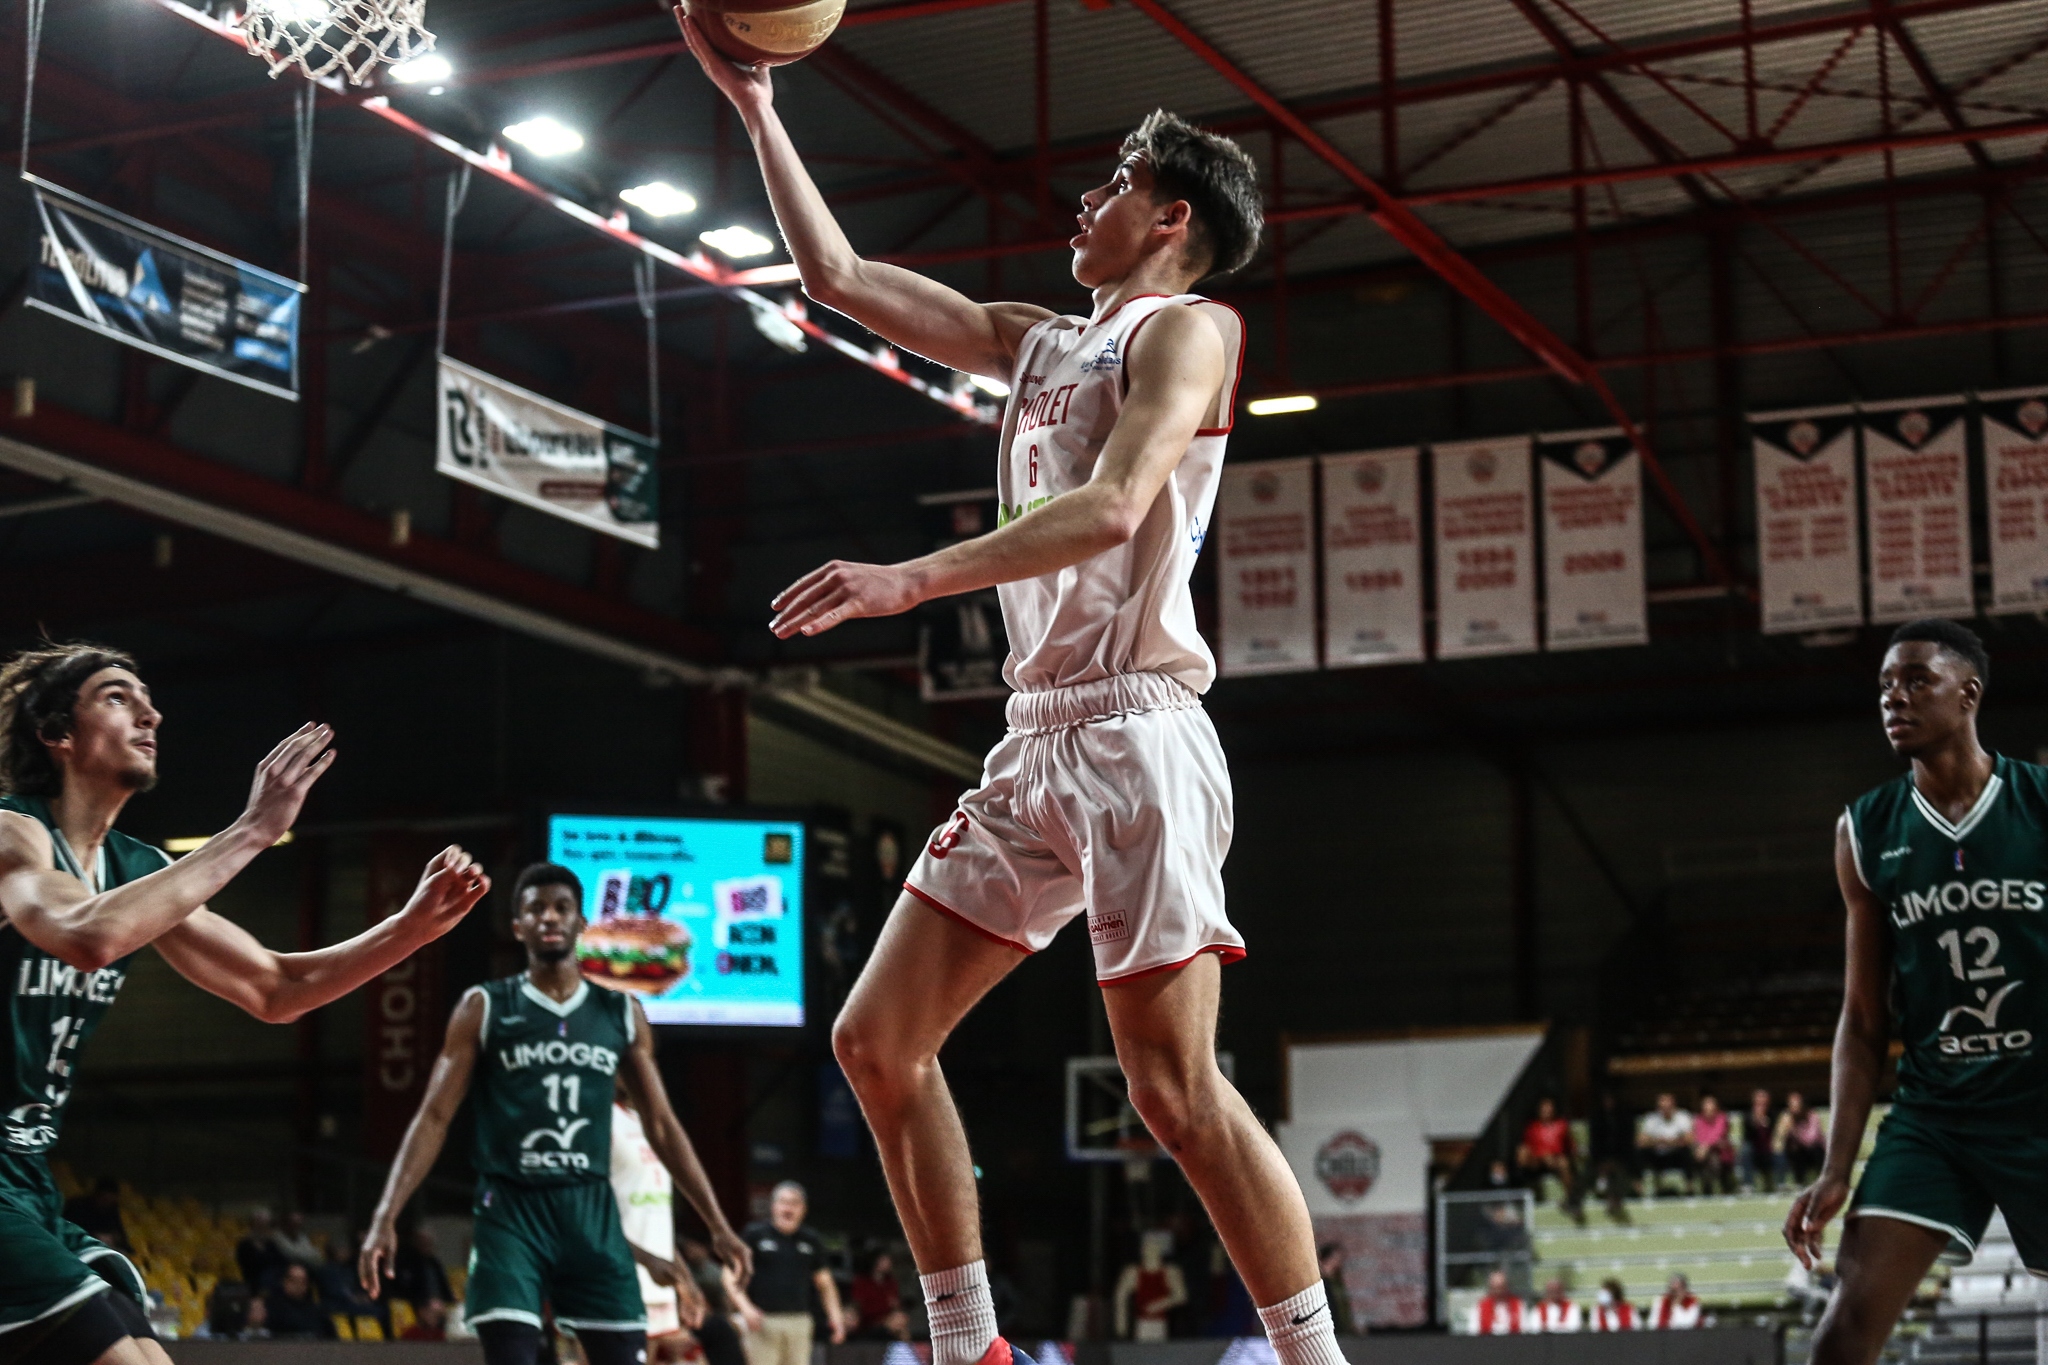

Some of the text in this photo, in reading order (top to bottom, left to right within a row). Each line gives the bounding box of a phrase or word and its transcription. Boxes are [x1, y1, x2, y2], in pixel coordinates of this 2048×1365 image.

[1029, 444, 1039, 488] 6
[928, 811, 970, 859] 6
[1891, 878, 2047, 929] LIMOGES
[1937, 926, 2006, 981] 12
[501, 1040, 619, 1076] LIMOGES
[541, 1073, 581, 1114] 11
